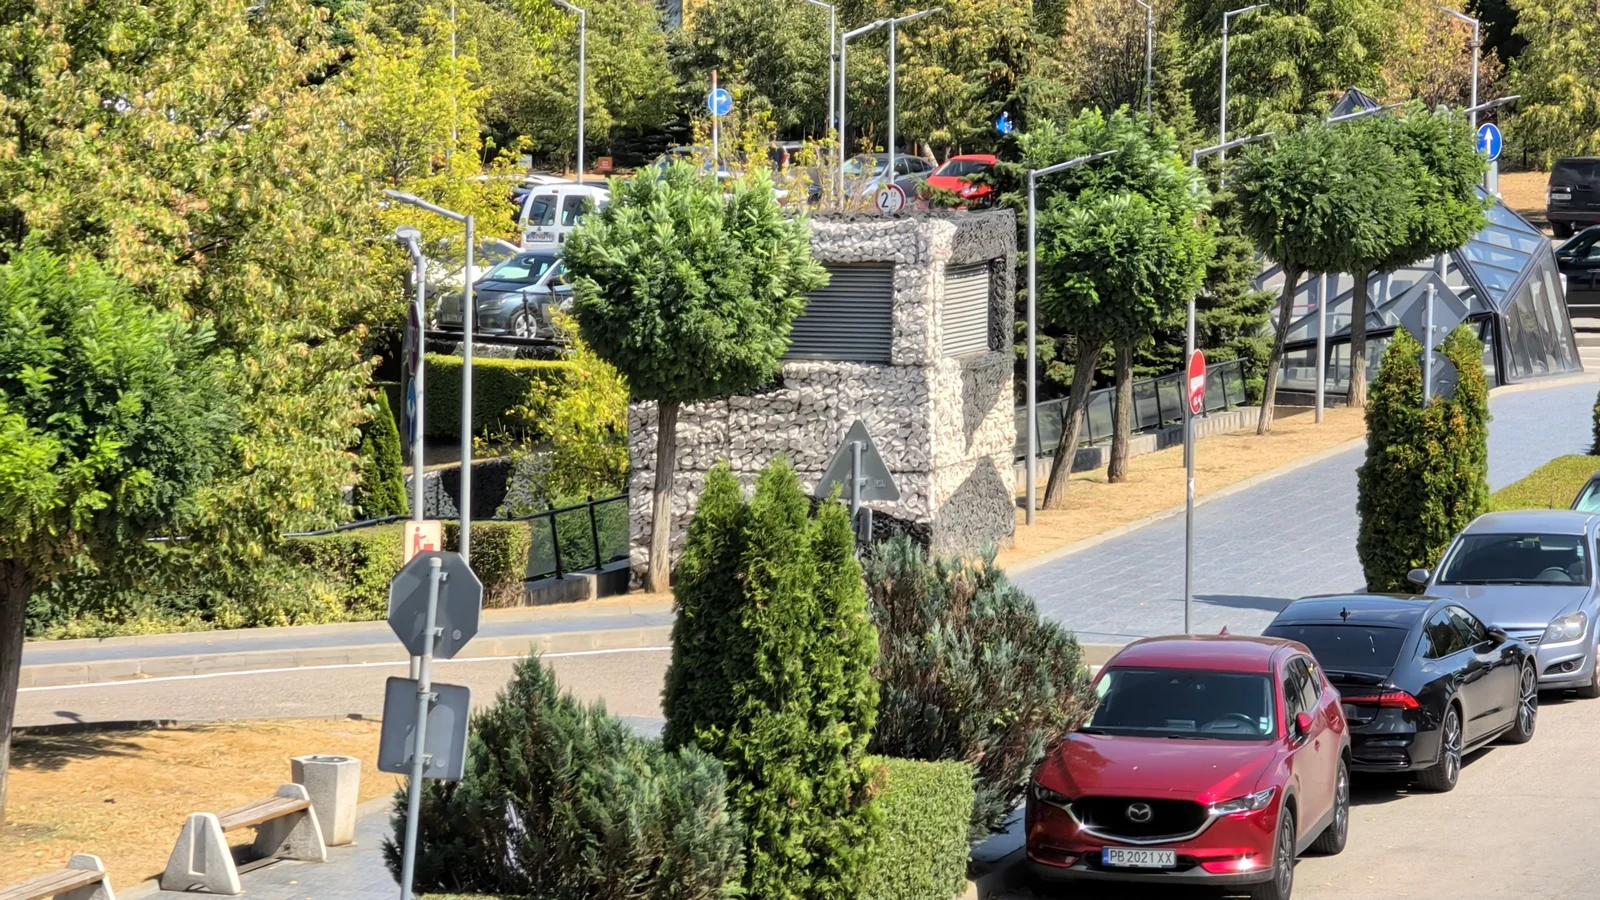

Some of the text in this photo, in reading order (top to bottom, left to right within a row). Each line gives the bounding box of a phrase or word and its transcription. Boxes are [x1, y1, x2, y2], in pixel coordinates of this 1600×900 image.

[1110, 850, 1172, 864] PB 2021 XX
